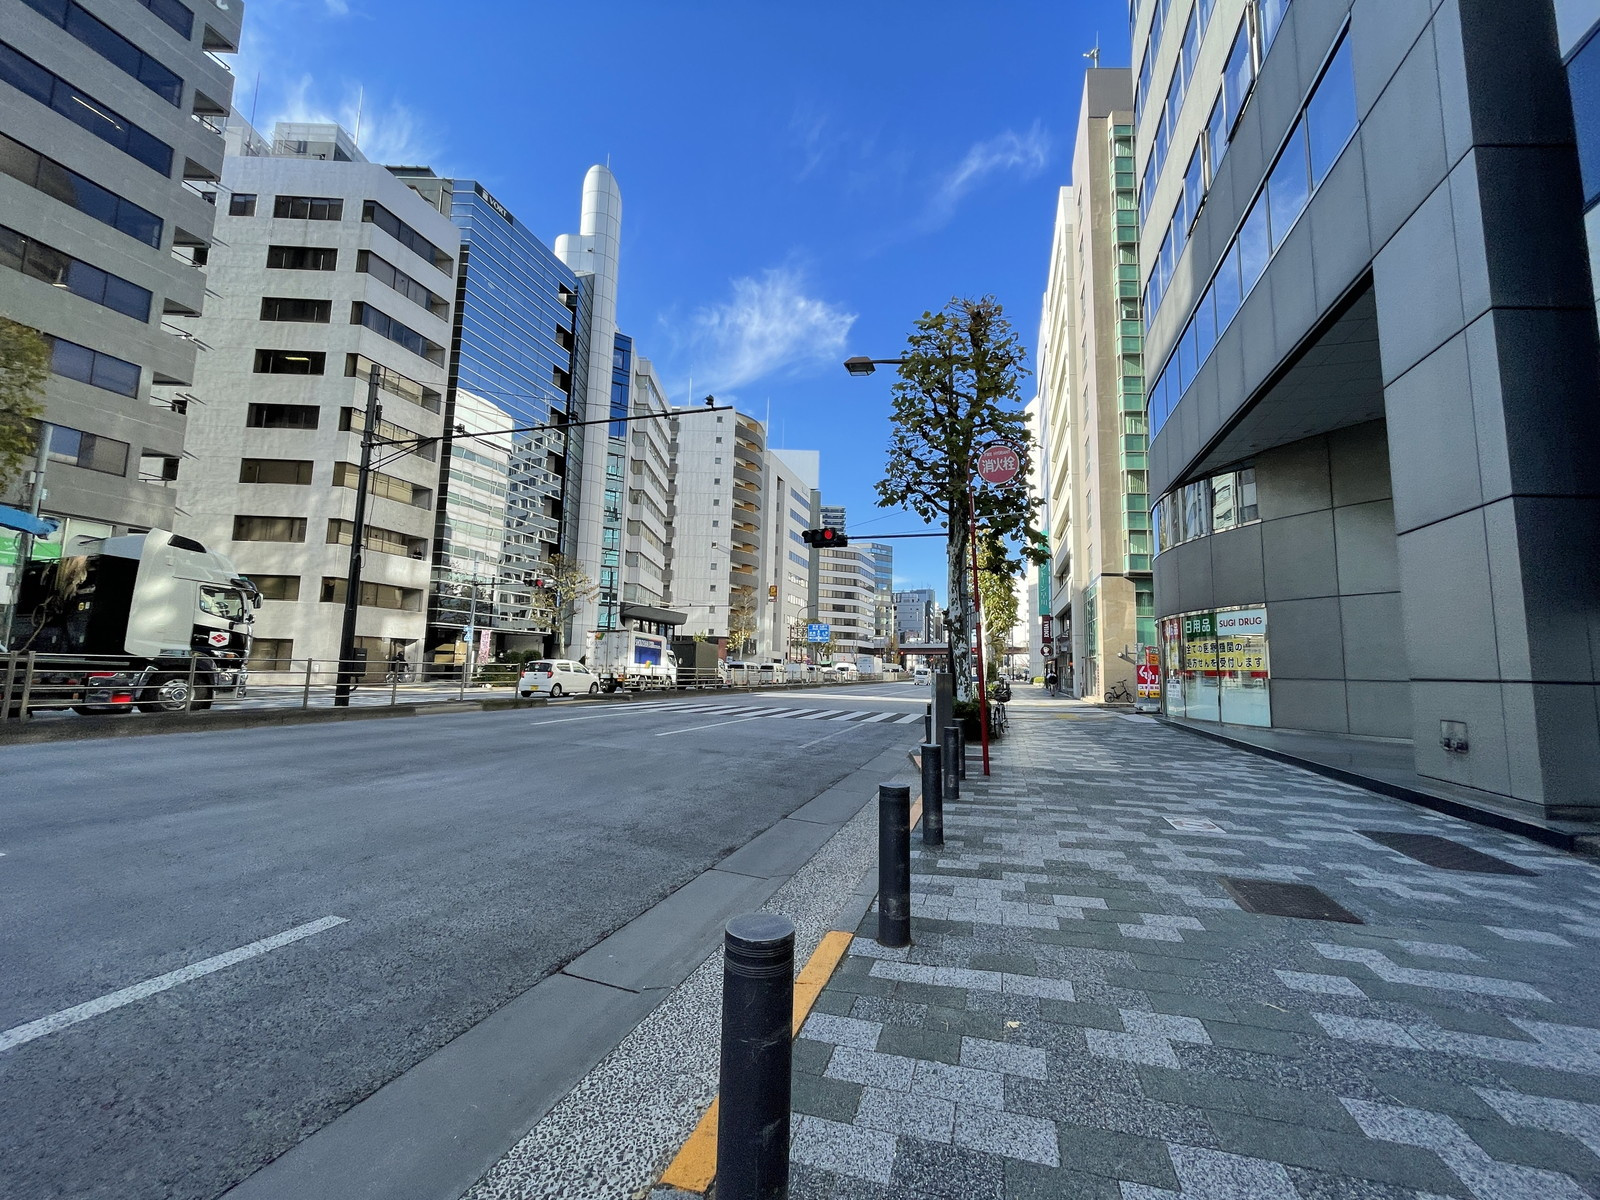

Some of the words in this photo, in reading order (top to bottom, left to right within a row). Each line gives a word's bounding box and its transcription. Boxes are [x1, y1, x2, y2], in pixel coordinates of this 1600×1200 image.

[489, 196, 507, 217] VORT
[982, 456, 1015, 473] 消火栓
[1185, 618, 1211, 634] 日用品
[1219, 619, 1236, 628] SUGI
[1239, 617, 1262, 626] DRUG
